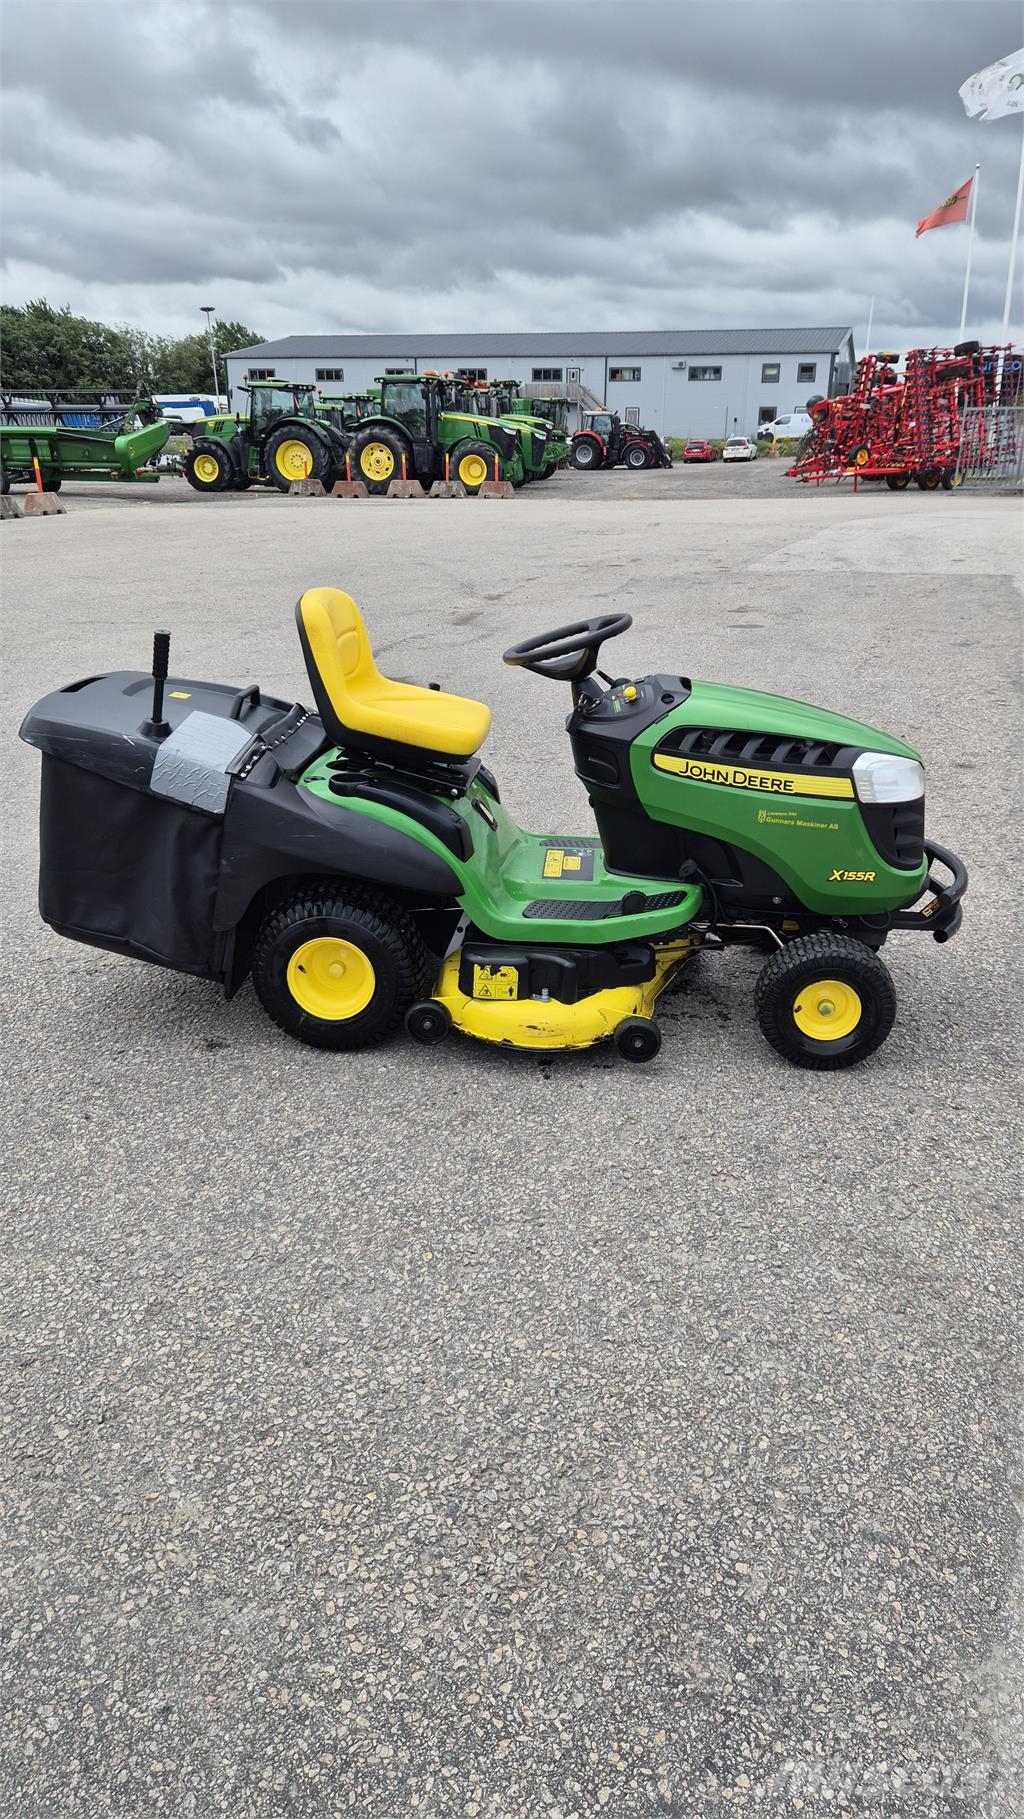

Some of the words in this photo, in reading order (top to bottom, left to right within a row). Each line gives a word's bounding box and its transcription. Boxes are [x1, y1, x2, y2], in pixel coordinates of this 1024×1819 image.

[679, 761, 729, 783] JOHN
[733, 770, 794, 791] DEERE
[766, 816, 795, 826] Gunnars
[796, 820, 828, 829] Maskiner
[828, 869, 876, 881] X155R
